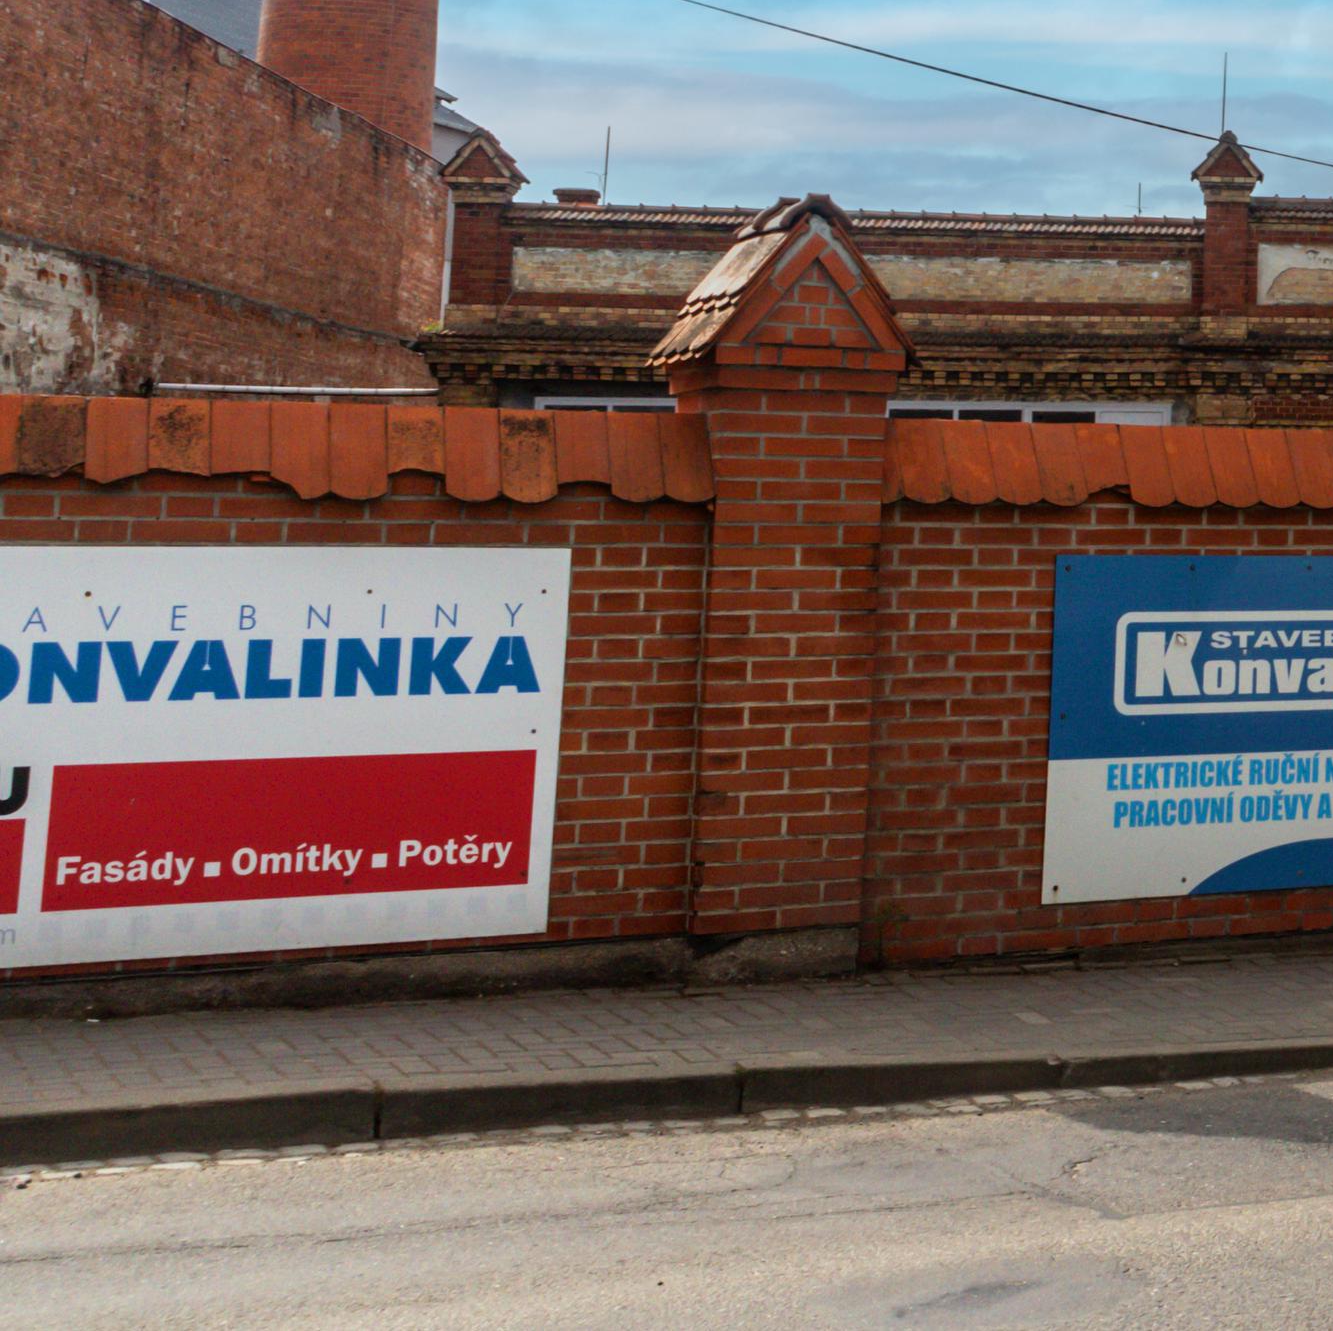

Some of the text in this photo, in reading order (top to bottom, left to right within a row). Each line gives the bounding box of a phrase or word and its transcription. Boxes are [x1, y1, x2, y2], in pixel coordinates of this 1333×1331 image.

[0, 636, 540, 704] NVALINKA
[1107, 755, 1243, 791] ELEKTRICKÉ
[1249, 752, 1320, 786] RUČNÍ
[1113, 794, 1234, 828] PRACOVNÍ
[1239, 790, 1314, 823] ODĚVY
[1317, 793, 1332, 819] A
[56, 834, 512, 886] Fasády Omítky Potěry
